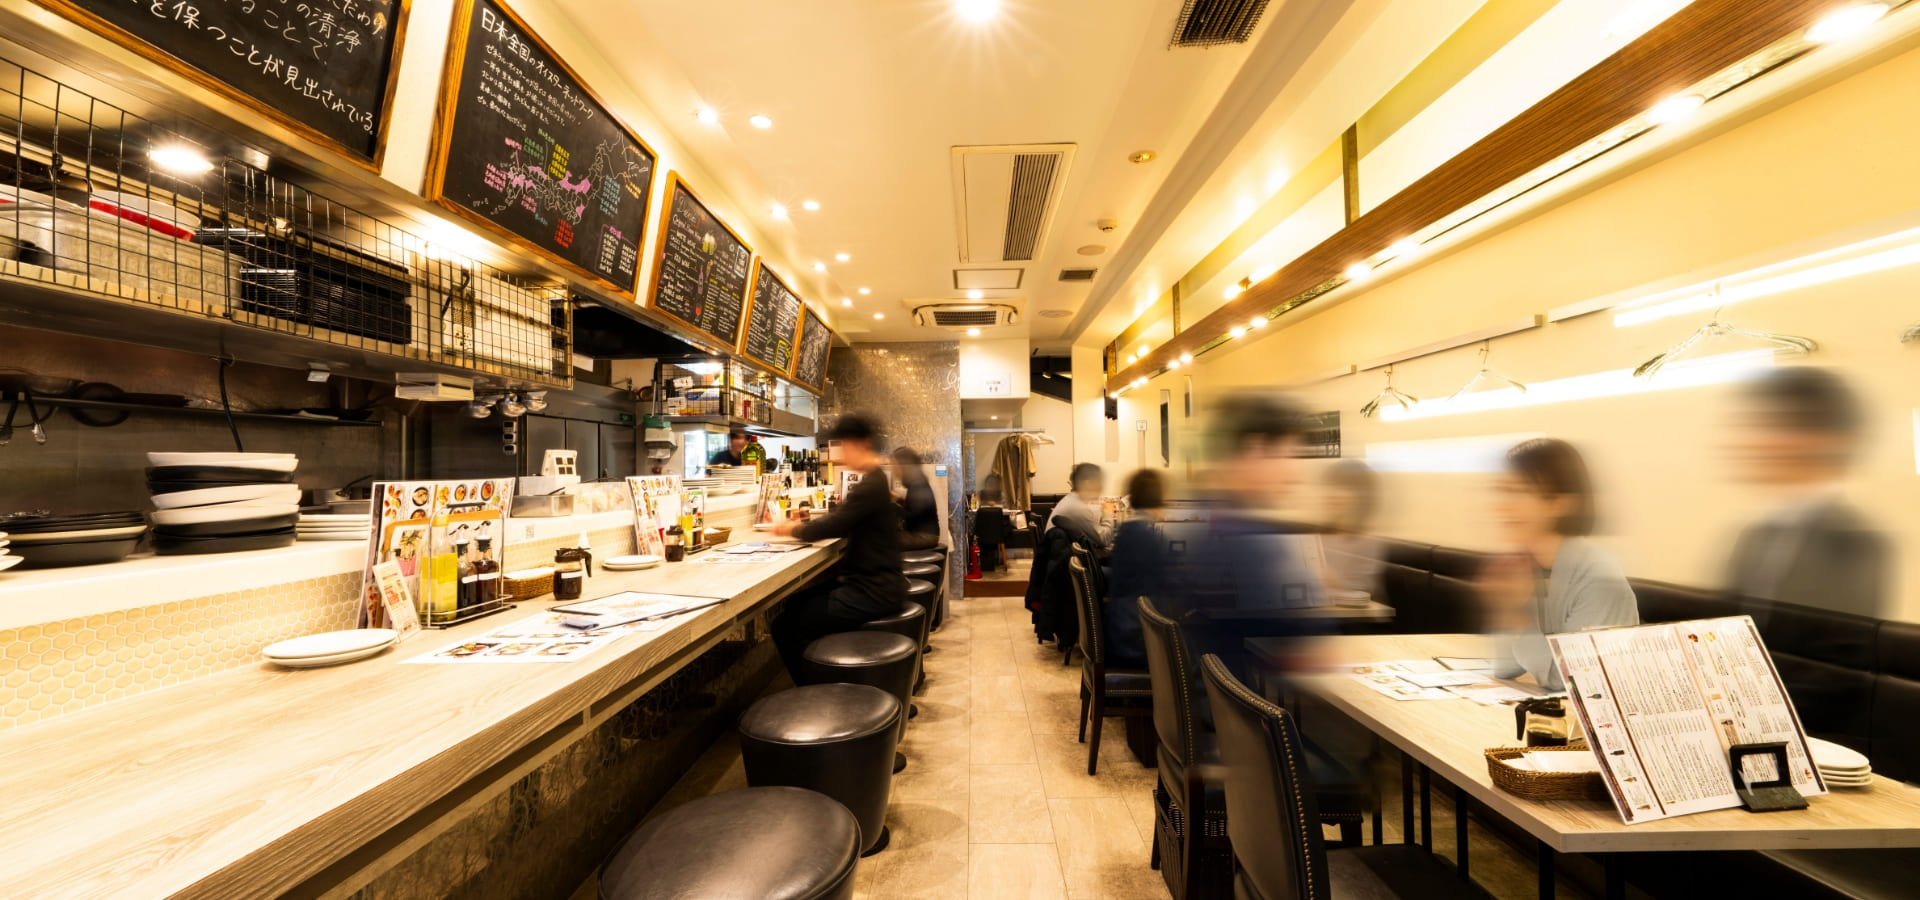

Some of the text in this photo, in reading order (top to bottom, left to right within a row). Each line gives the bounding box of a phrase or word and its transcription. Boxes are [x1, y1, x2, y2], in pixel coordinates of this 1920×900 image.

[481, 7, 594, 120] 日本全国のオイスターネットワーク
